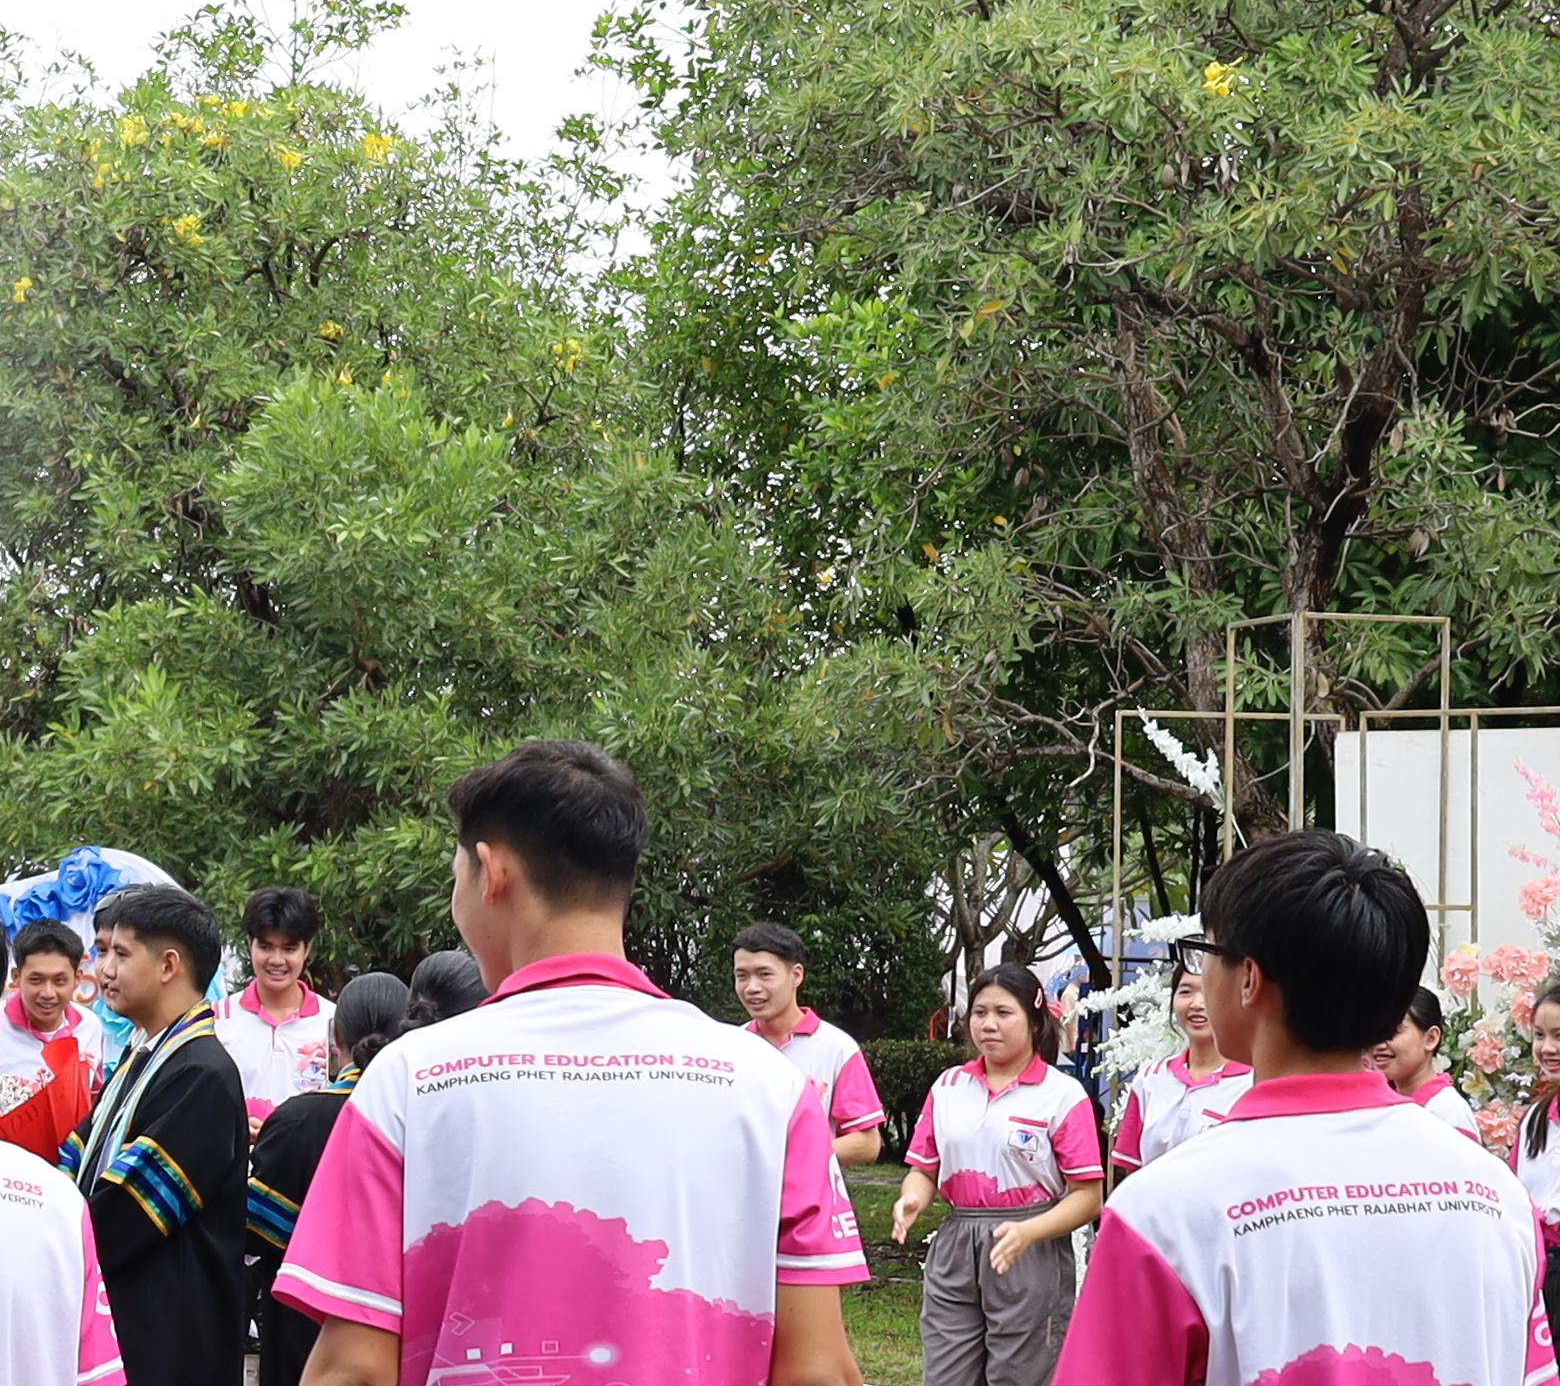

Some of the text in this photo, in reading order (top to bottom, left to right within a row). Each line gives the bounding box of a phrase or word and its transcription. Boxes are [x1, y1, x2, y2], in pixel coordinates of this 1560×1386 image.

[414, 1053, 736, 1081] COMPUTER EDUCATION 2025
[416, 1069, 735, 1096] KAMPHAENG PHET RAJABHAT UNIVERSITY
[2, 1177, 43, 1196] 2025
[1226, 1180, 1501, 1221] COMPUTER EDUCATION 2025
[1233, 1204, 1324, 1238] KAMPHAENG
[1327, 1204, 1359, 1217] PHET
[1364, 1201, 1433, 1215] RAJABHAT
